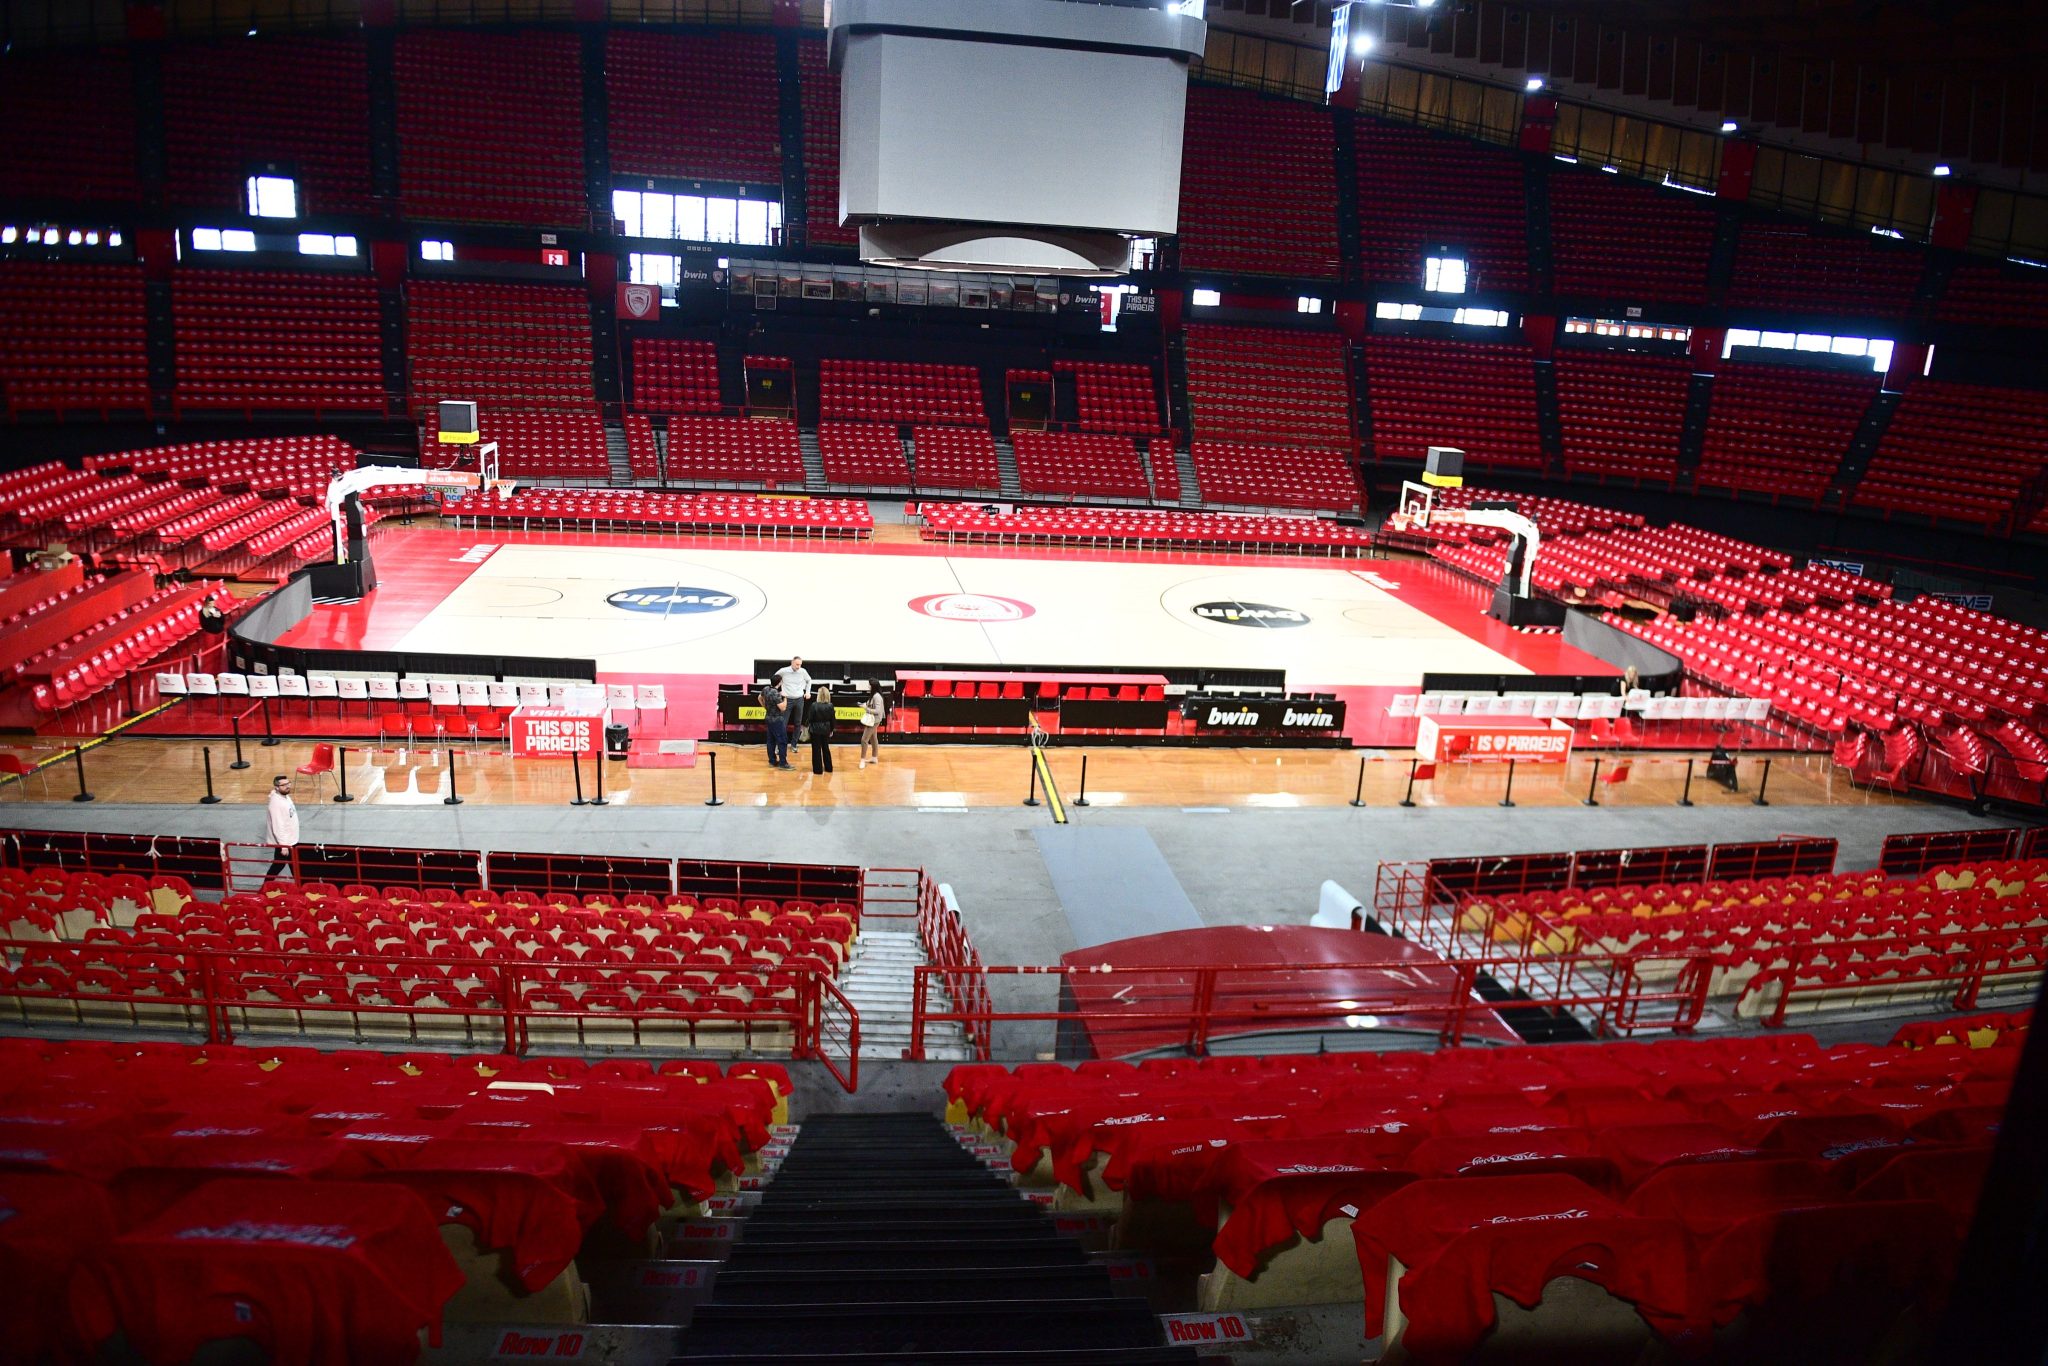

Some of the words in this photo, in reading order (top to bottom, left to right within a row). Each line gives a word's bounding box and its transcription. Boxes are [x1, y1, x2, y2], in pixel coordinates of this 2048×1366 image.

[684, 270, 707, 280] bwin
[1075, 294, 1097, 304] bwin
[1127, 295, 1142, 303] THIS
[1207, 706, 1259, 725] bwin
[1282, 707, 1334, 726] bwin
[525, 720, 560, 736] THIS
[575, 720, 590, 736] IS
[1477, 735, 1492, 751] IS
[752, 1178, 759, 1187] 6
[728, 1199, 736, 1209] 7
[684, 1226, 715, 1238] Row
[642, 1269, 681, 1285] Row
[1168, 1319, 1216, 1341] Row
[1217, 1316, 1245, 1338] 10
[498, 1331, 553, 1355] Row
[554, 1333, 584, 1357] 10
